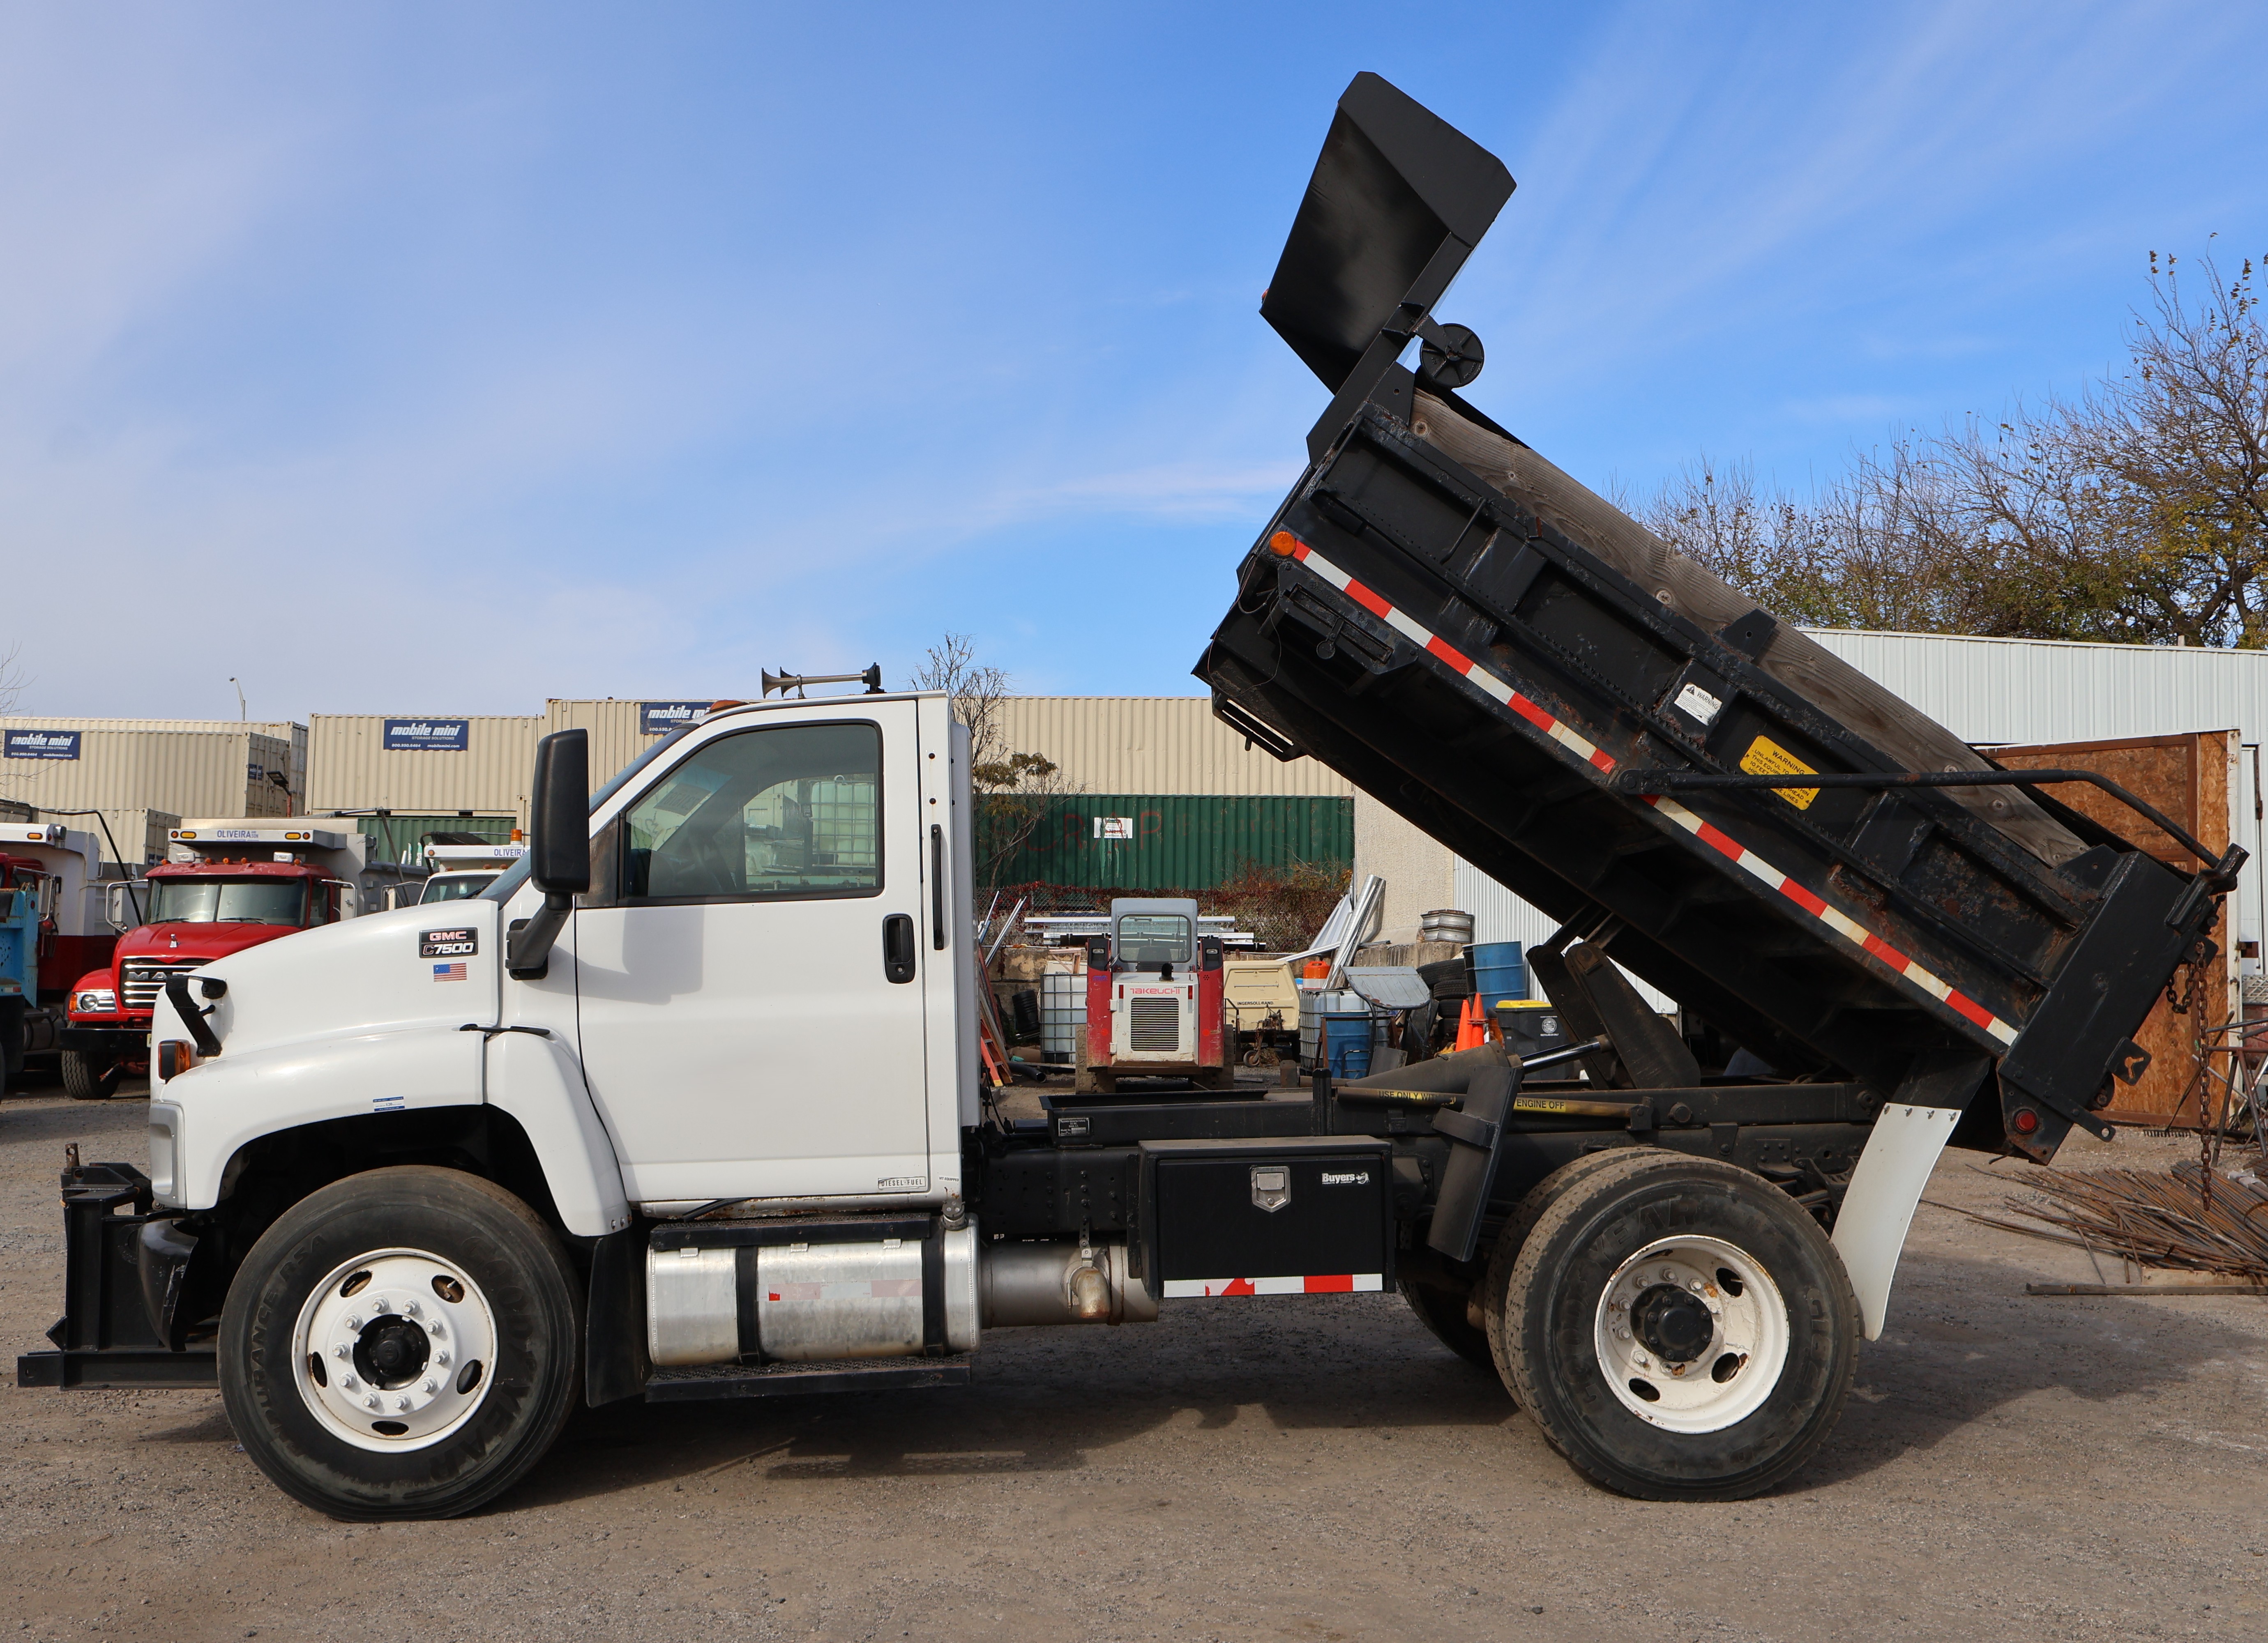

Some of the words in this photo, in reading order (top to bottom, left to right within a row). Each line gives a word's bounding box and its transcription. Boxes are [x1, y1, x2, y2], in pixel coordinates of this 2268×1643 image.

[1697, 691, 1718, 709] WARNING
[648, 705, 691, 719] mobile
[692, 707, 711, 719] mi
[390, 723, 432, 735] mobile
[432, 725, 461, 736] mini
[10, 734, 47, 746] mobile
[48, 736, 74, 746] mini
[1752, 755, 1763, 765] THIS
[1763, 763, 1781, 775] EQUIP
[1755, 749, 1781, 771] UNLAWFUL
[1772, 750, 1805, 775] WARNING
[1783, 791, 1799, 804] LINES
[494, 849, 526, 857] OLIVEIRA
[430, 931, 467, 941] GMC
[423, 942, 474, 955] C7500
[1397, 1092, 1418, 1100] ONLY
[1517, 1099, 1547, 1108] ENGINE
[1549, 1101, 1565, 1109] OFF
[1322, 1173, 1355, 1184] Buyers
[280, 1234, 328, 1282] RSA
[1558, 1195, 1698, 1413] GOODYEAR
[428, 1236, 535, 1481] GOODYEAR
